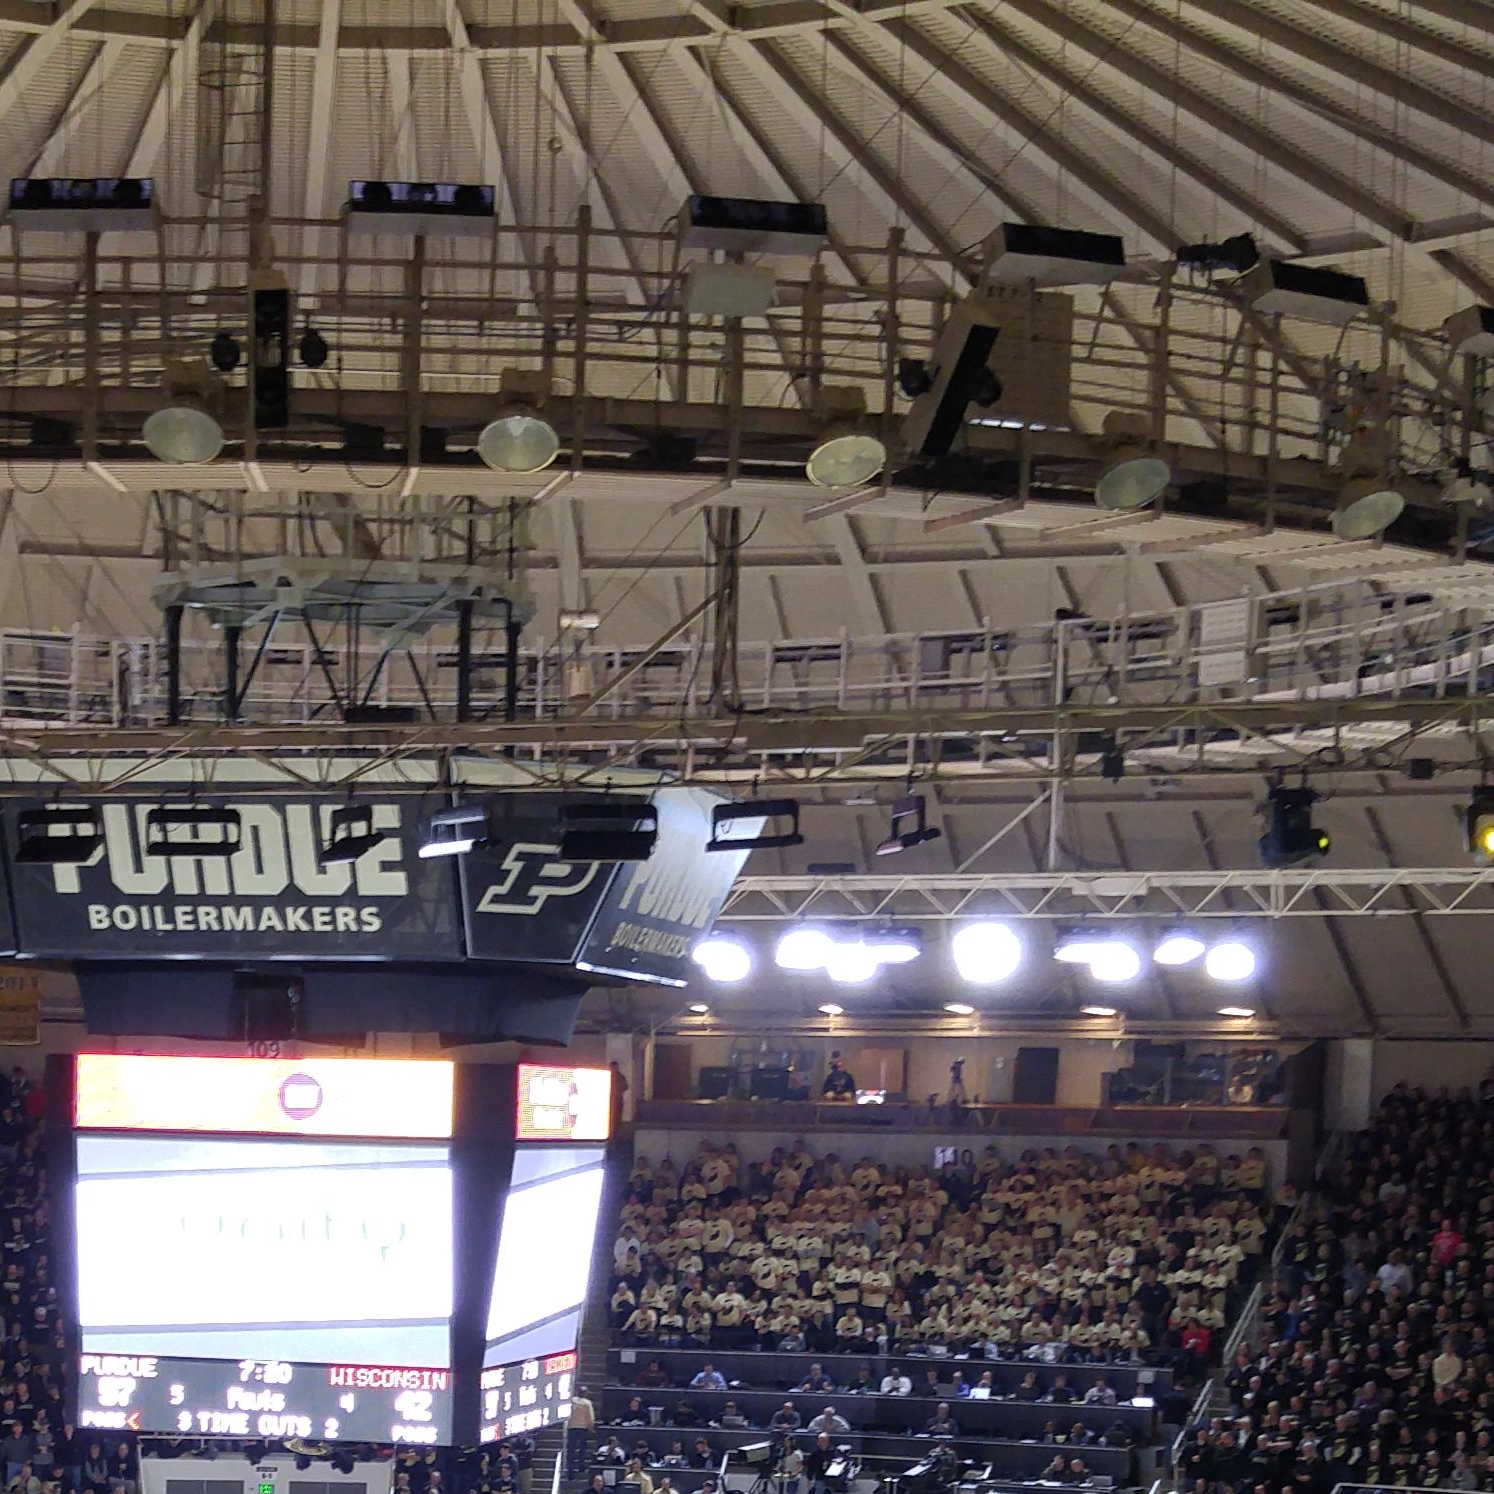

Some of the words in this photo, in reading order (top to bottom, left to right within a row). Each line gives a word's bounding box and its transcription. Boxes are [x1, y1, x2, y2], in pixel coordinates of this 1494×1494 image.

[45, 803, 408, 896] PURDUE
[88, 904, 382, 933] BOILERMAKERS
[610, 921, 693, 958] BOILERMAKERS
[81, 1356, 159, 1378] PURDUE
[330, 1367, 447, 1390] WISCONSIN
[197, 1411, 250, 1434] TIME
[258, 1415, 312, 1437] OUTS
[324, 1418, 340, 1438] 2
